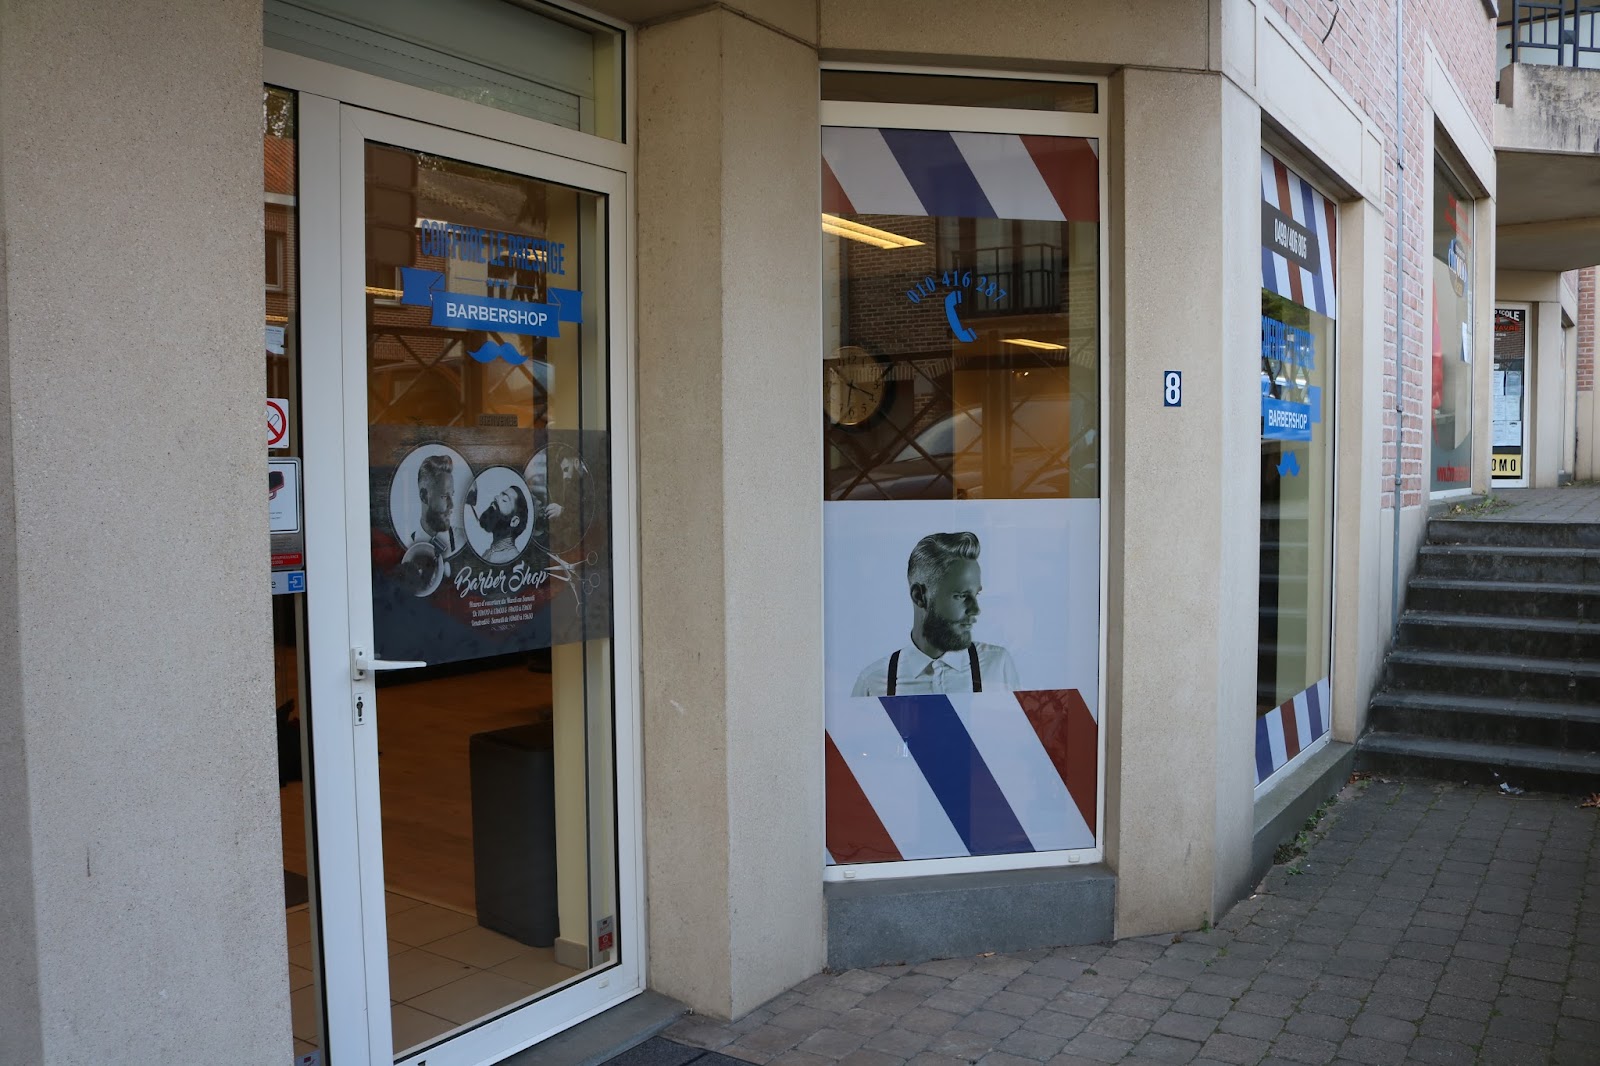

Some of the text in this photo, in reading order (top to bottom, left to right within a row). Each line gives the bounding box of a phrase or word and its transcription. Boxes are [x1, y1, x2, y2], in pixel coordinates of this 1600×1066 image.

[421, 219, 566, 276] COIFFURE LE PRESTIGE
[906, 270, 1008, 304] 010 416 287
[446, 301, 548, 327] BARBERSHOP
[1165, 372, 1180, 405] 8
[1268, 409, 1308, 430] BARBERSHOP
[454, 560, 549, 598] Barber Shop
